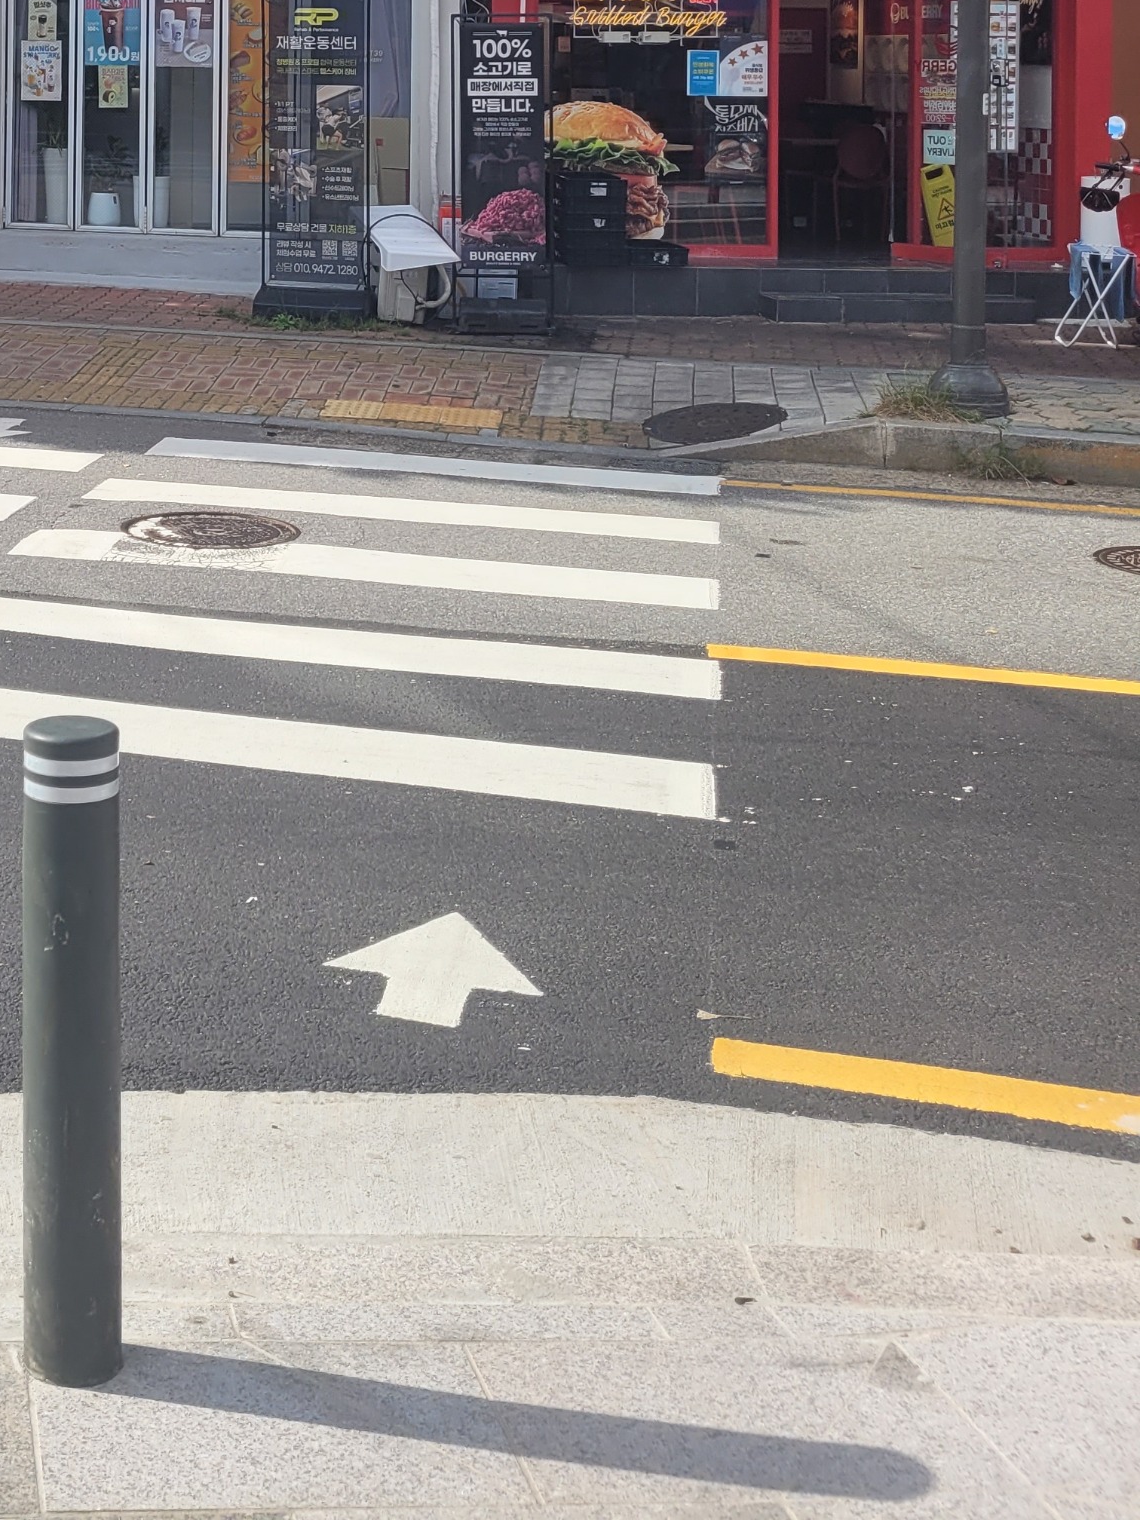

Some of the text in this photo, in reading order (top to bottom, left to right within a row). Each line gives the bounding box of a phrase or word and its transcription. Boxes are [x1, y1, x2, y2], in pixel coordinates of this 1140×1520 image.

[570, 4, 728, 38] Grilled Burger
[276, 35, 357, 50] 재활운동센터
[472, 38, 533, 59] 100%
[473, 61, 532, 76] 소고기로
[472, 98, 535, 113] 만듭니다.
[276, 222, 310, 232] 무료상담
[304, 240, 312, 249] 시
[469, 251, 537, 262] BURGERRY
